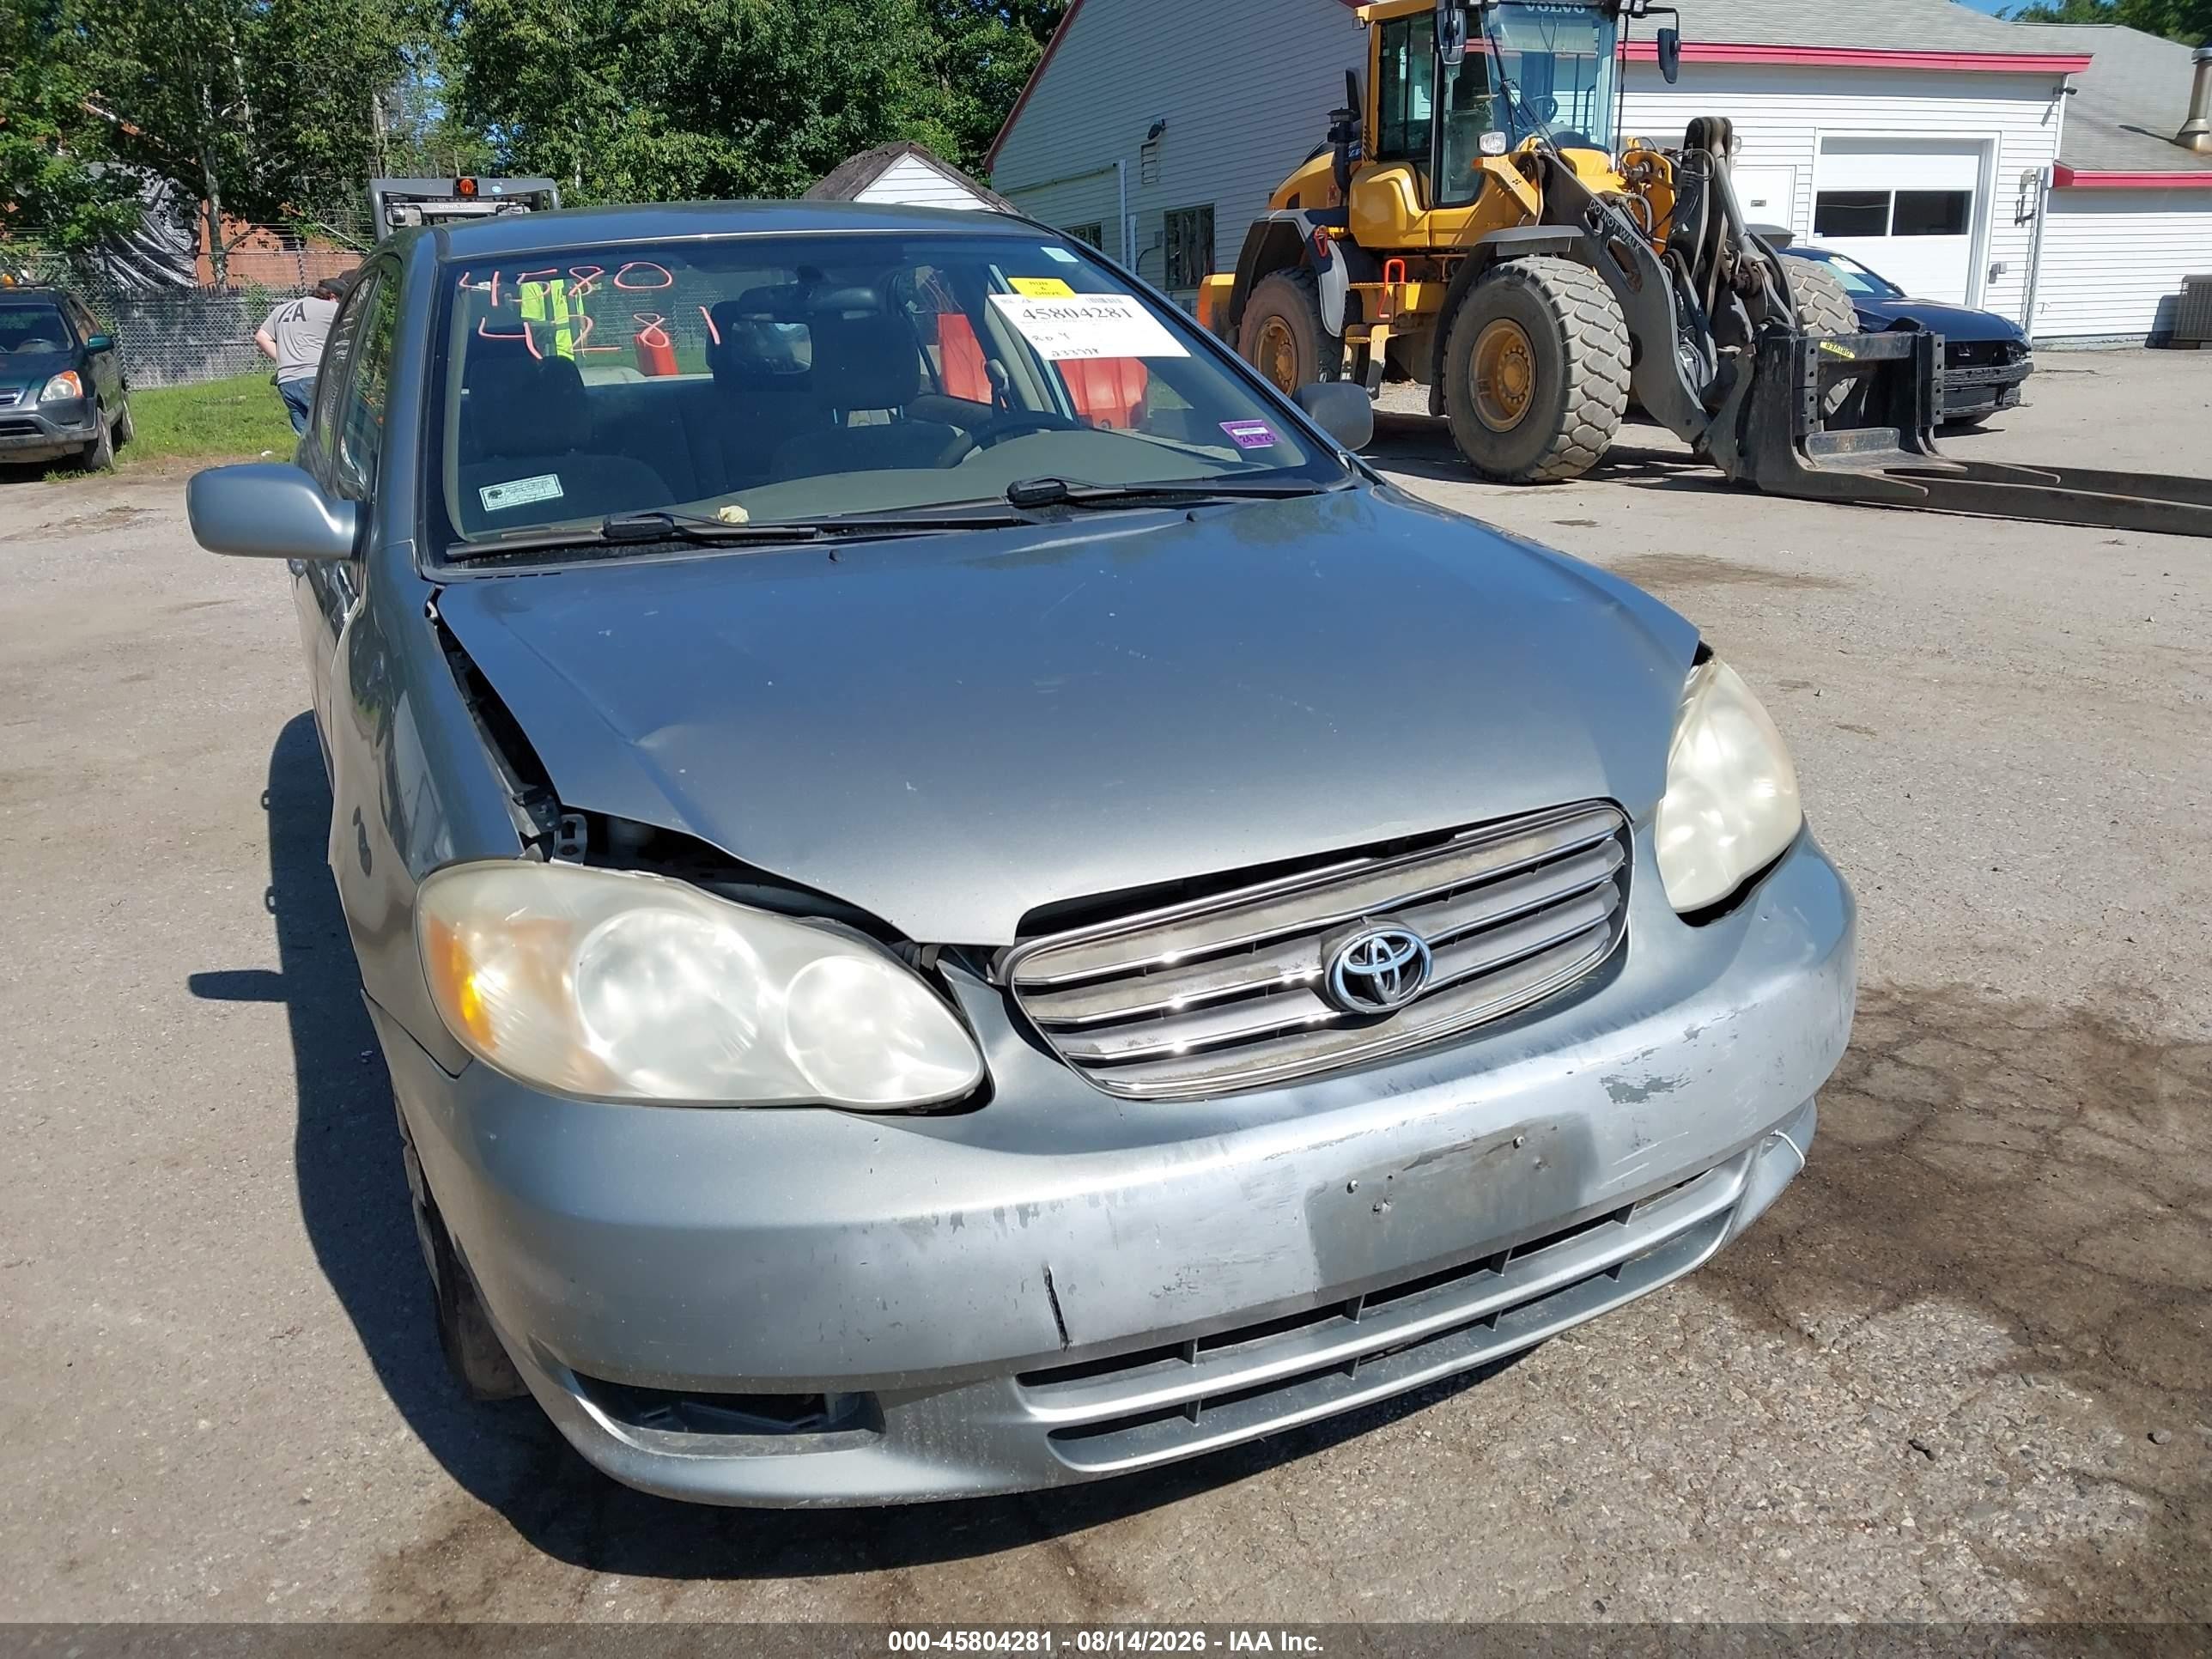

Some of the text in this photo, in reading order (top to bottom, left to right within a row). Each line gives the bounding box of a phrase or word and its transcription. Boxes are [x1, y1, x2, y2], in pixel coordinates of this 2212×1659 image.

[1525, 4, 1586, 14] VOLVO
[1589, 198, 1642, 254] DO NOT WALK
[459, 261, 673, 307] 4580
[1023, 307, 1133, 319] 45804281
[1826, 342, 1851, 356] DRIVER
